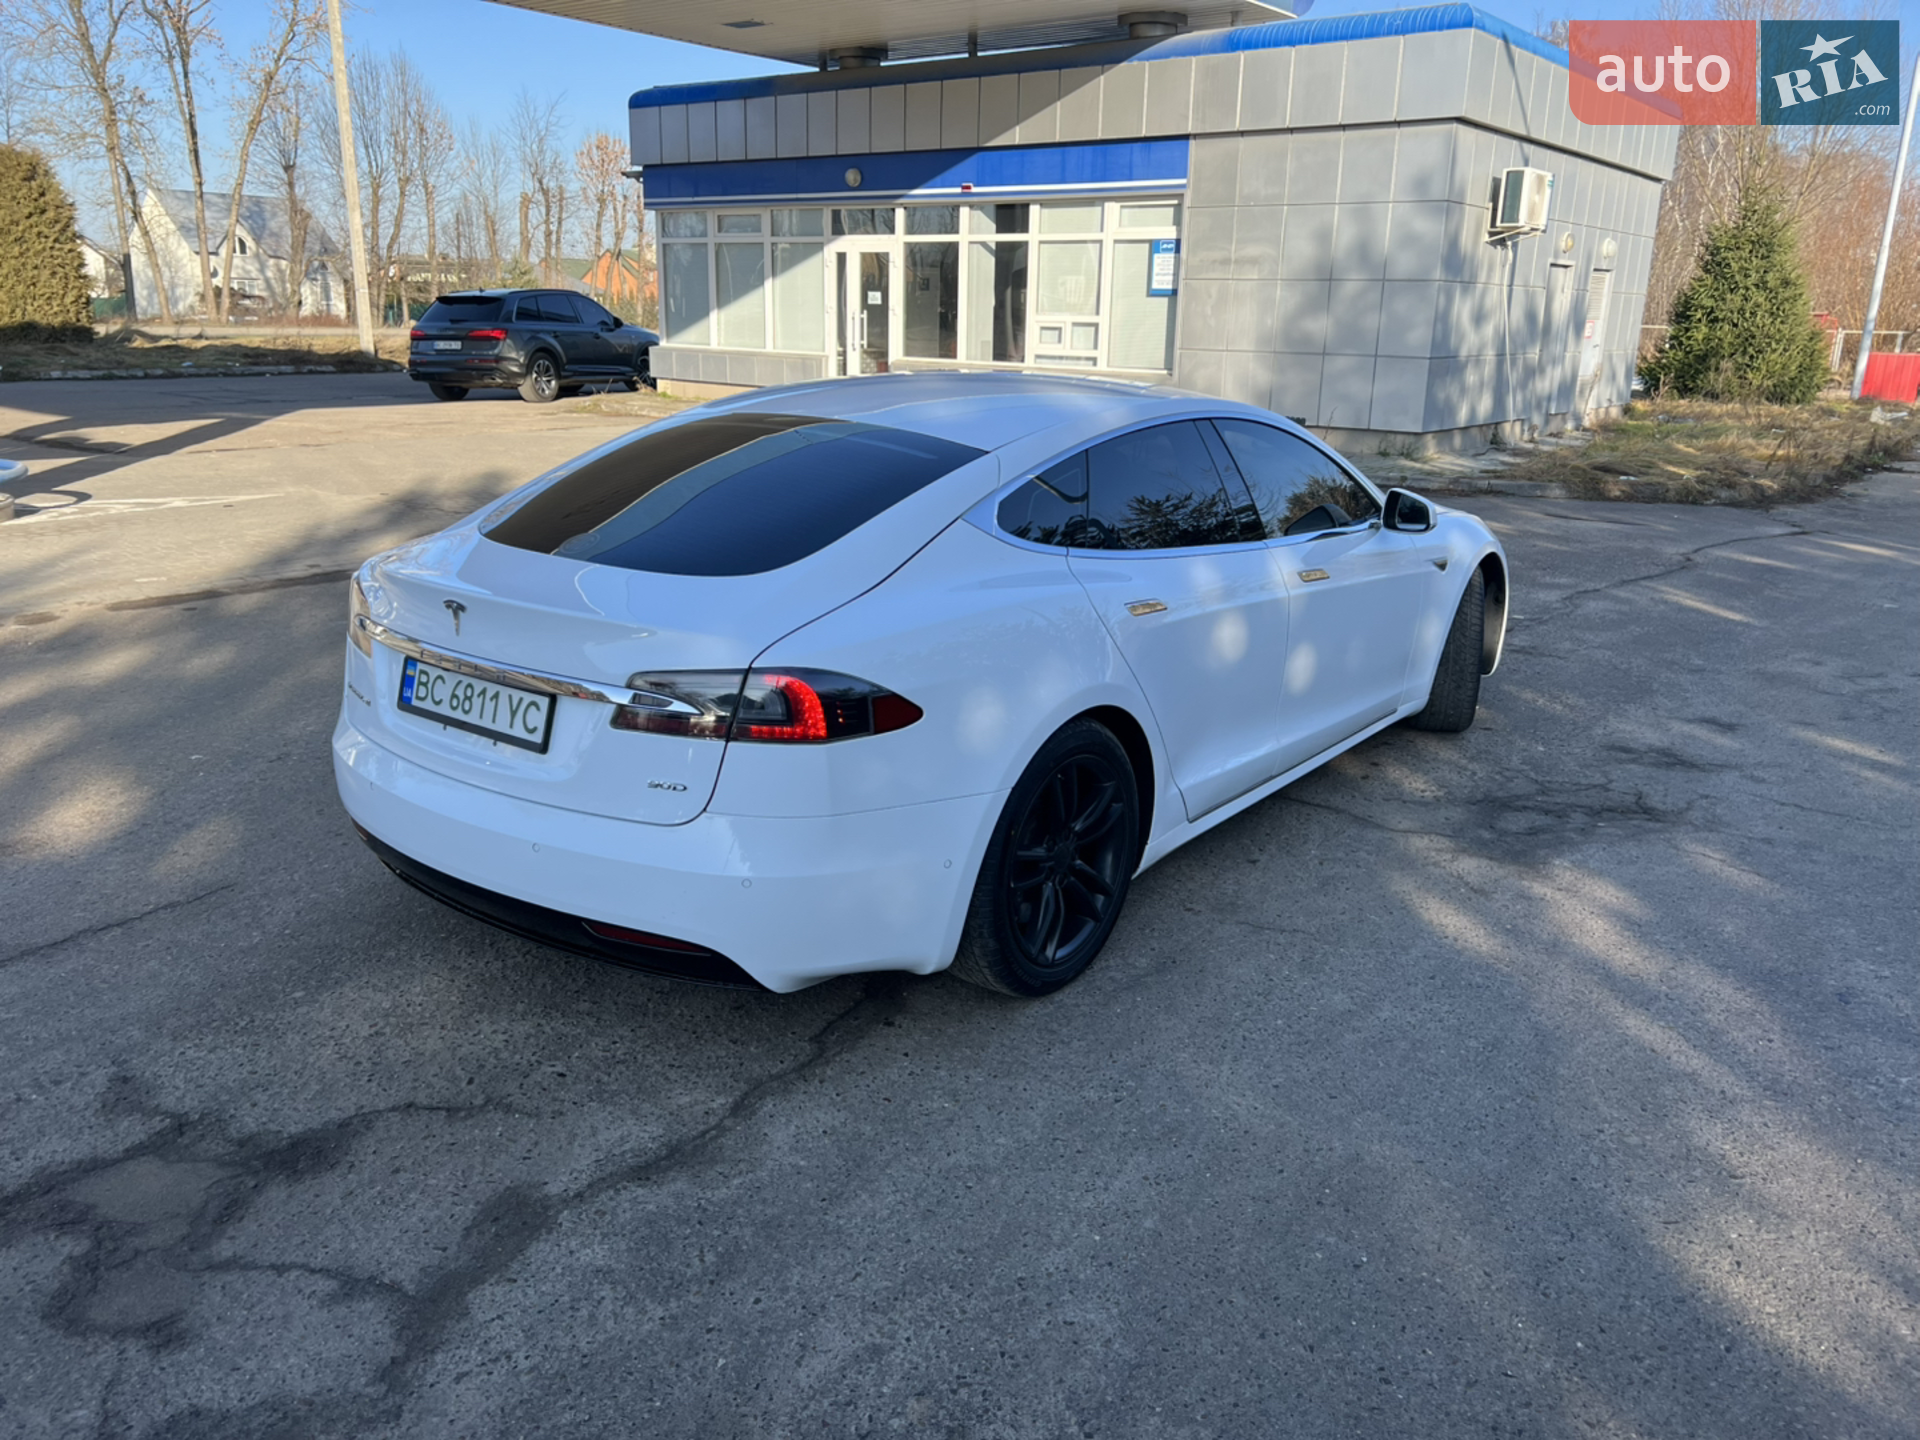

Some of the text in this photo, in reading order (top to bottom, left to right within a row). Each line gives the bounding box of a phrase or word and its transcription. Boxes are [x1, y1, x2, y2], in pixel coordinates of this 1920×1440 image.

[415, 669, 446, 706] BC
[449, 679, 500, 724] 6811
[508, 693, 541, 734] YC
